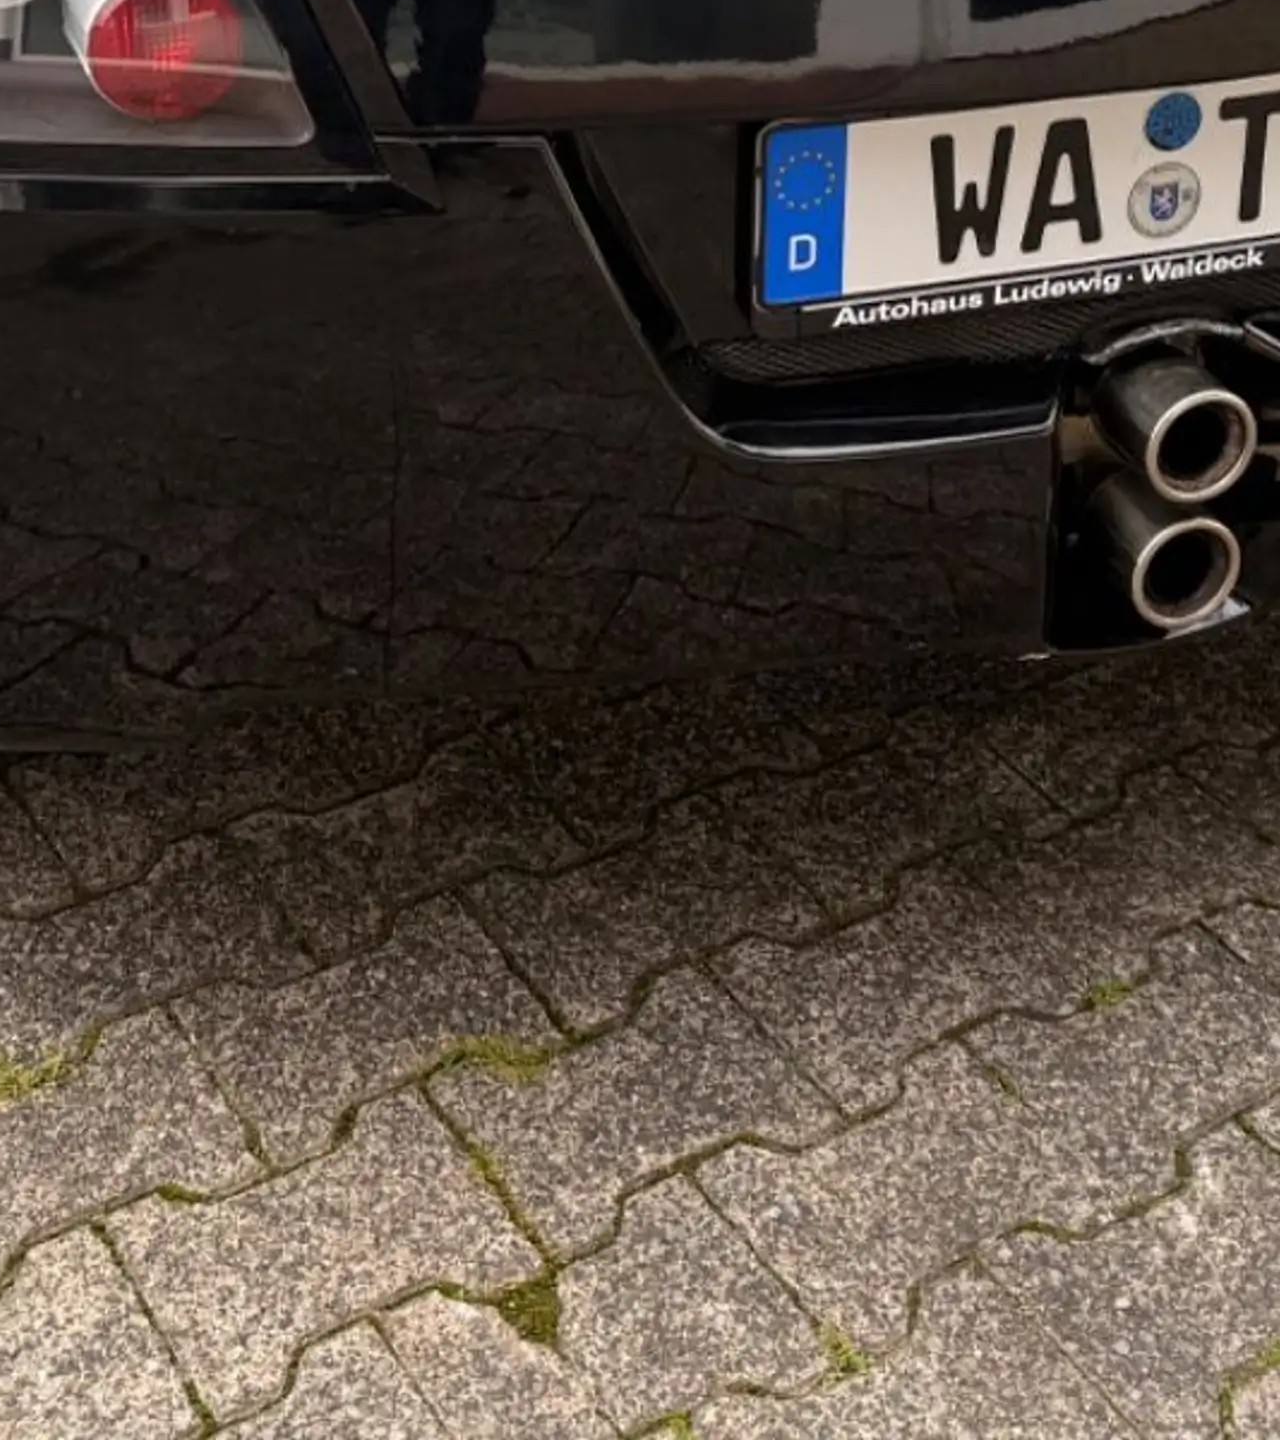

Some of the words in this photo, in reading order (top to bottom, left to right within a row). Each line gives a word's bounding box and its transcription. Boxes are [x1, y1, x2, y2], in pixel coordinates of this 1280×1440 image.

[930, 117, 1102, 264] WA
[789, 234, 817, 271] D
[832, 290, 983, 328] Autohaus
[994, 269, 1122, 306] Ludewig
[1141, 247, 1264, 285] Waldeck
